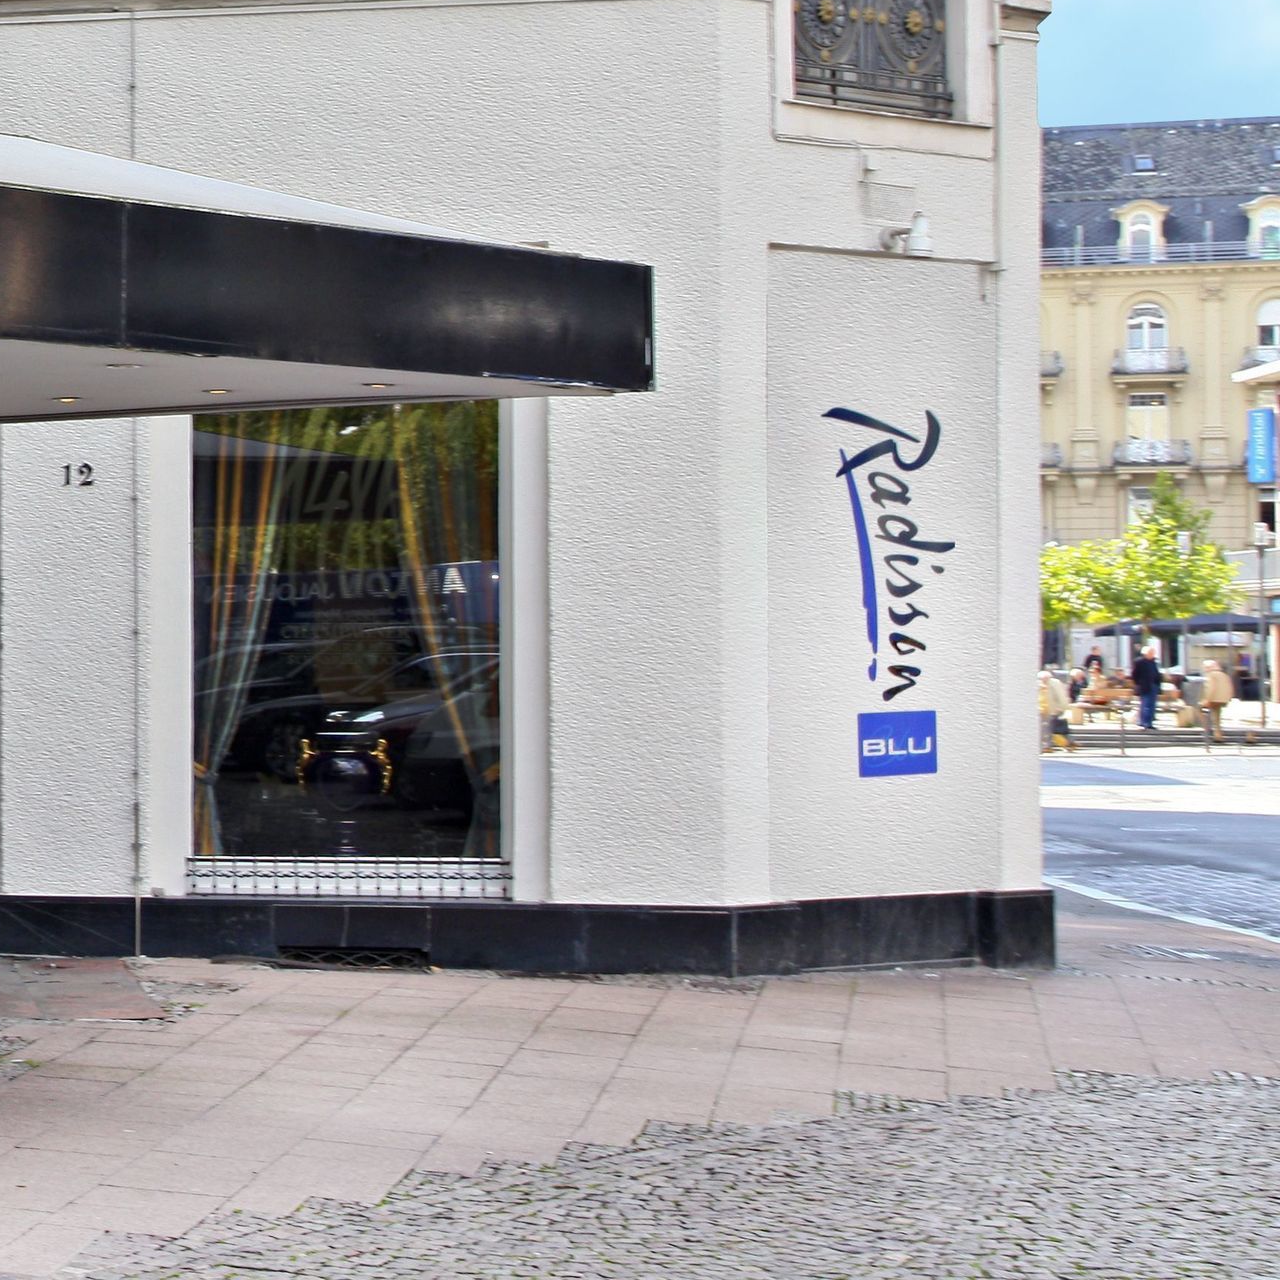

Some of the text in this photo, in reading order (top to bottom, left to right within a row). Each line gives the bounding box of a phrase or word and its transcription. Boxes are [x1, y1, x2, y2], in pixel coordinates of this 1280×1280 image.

[60, 462, 94, 486] 12
[821, 407, 955, 701] Radisson
[863, 735, 932, 757] BLU
